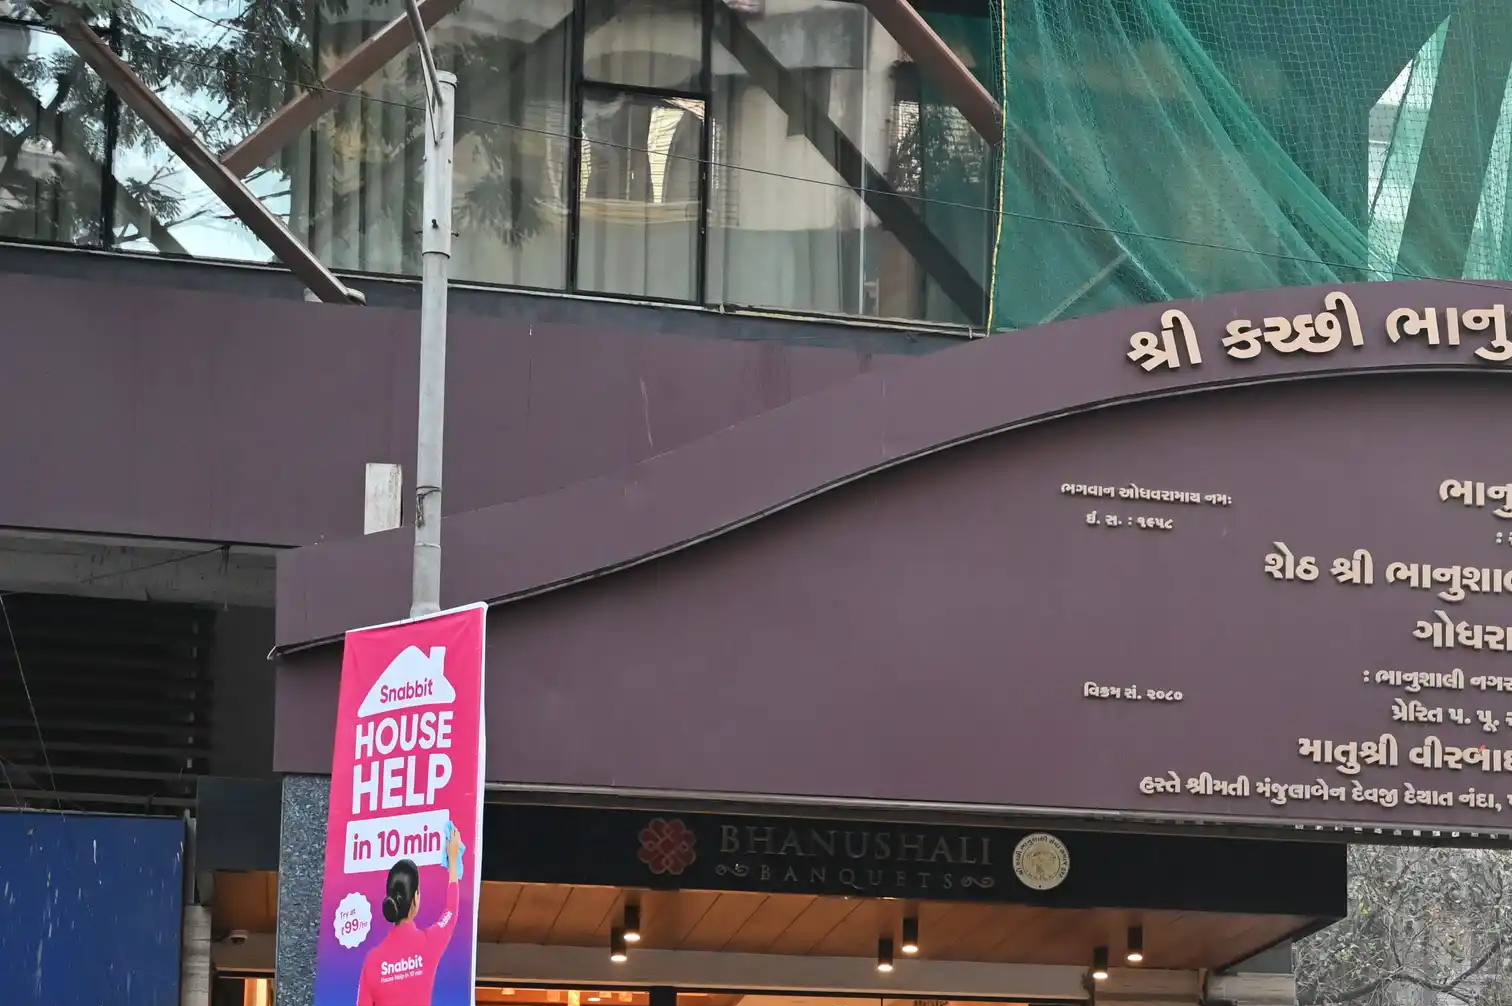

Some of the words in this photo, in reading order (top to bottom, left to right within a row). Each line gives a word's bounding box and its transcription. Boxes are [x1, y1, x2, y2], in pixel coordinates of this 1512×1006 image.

[1126, 309, 1202, 372] શ્રી
[1221, 291, 1364, 360] કચ્છી
[1061, 483, 1115, 498] ભગવાન
[1118, 483, 1201, 503] ઓધવરામાય
[1264, 541, 1319, 581] શેઠ
[1329, 549, 1374, 585] શ્રી
[379, 677, 433, 704] Snabbit
[1375, 668, 1465, 693] ભાનુશાલી
[1391, 697, 1444, 724] પ્રેરિત
[354, 710, 454, 760] HOUSE
[1298, 733, 1399, 775] માતુશ્રી
[352, 753, 452, 815] HELP
[1139, 771, 1181, 794] હસ્તે
[1185, 771, 1250, 797] શ્રીમતી
[1255, 777, 1346, 805] મંજુલાબેન
[1351, 780, 1399, 807] દેવજી
[1458, 788, 1502, 812] નંદા,
[352, 833, 371, 861] in
[377, 828, 400, 858] 10
[403, 825, 441, 854] min
[720, 824, 993, 866] BHANUSHALI
[760, 864, 953, 891] BANQUETS
[380, 954, 424, 976] Snabbit
